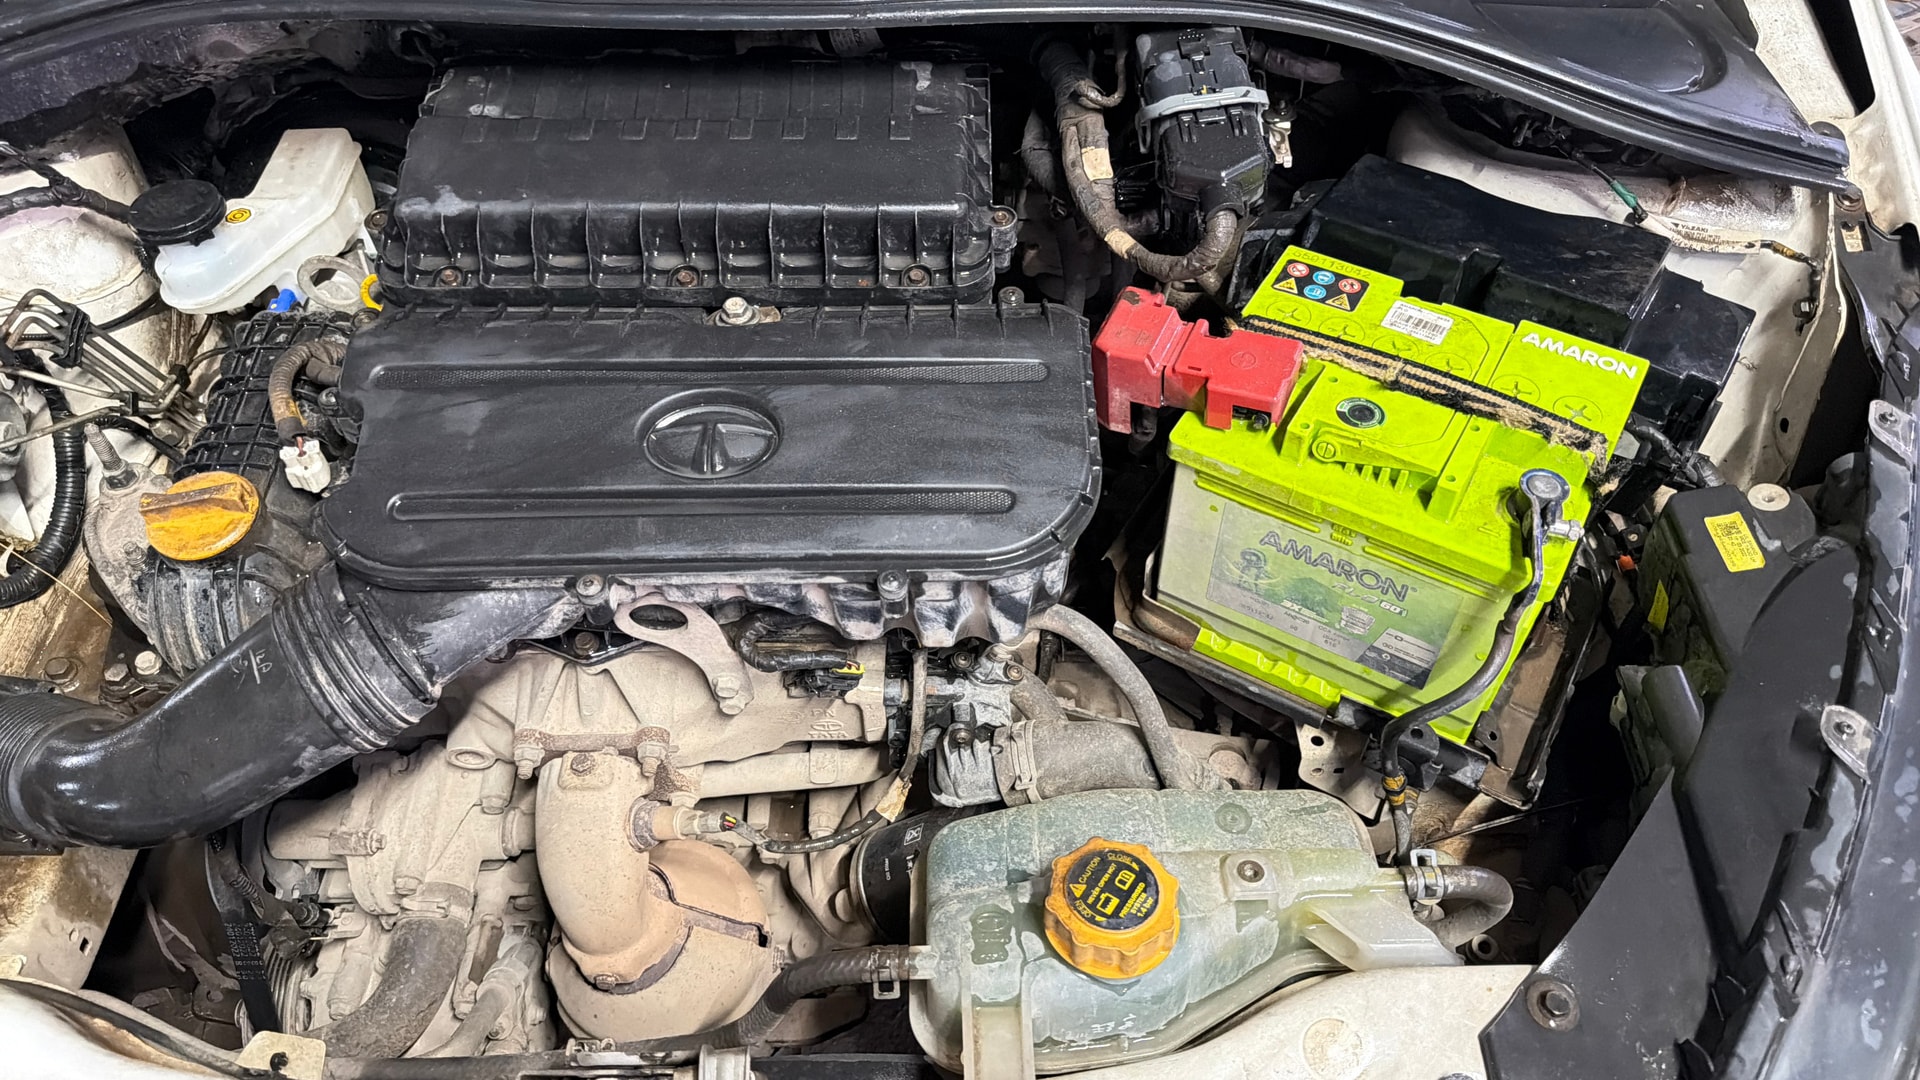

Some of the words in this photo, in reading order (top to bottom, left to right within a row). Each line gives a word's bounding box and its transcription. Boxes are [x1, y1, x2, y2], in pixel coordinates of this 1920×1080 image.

[1681, 223, 1709, 233] YAZAKI
[1521, 332, 1638, 379] AMARON
[1259, 530, 1409, 602] AMARON
[1079, 857, 1101, 883] CAUTION
[1098, 873, 1110, 888] OPEN
[1130, 892, 1147, 914] SYSTEM
[1137, 907, 1148, 917] 1.4
[1143, 897, 1154, 908] bar
